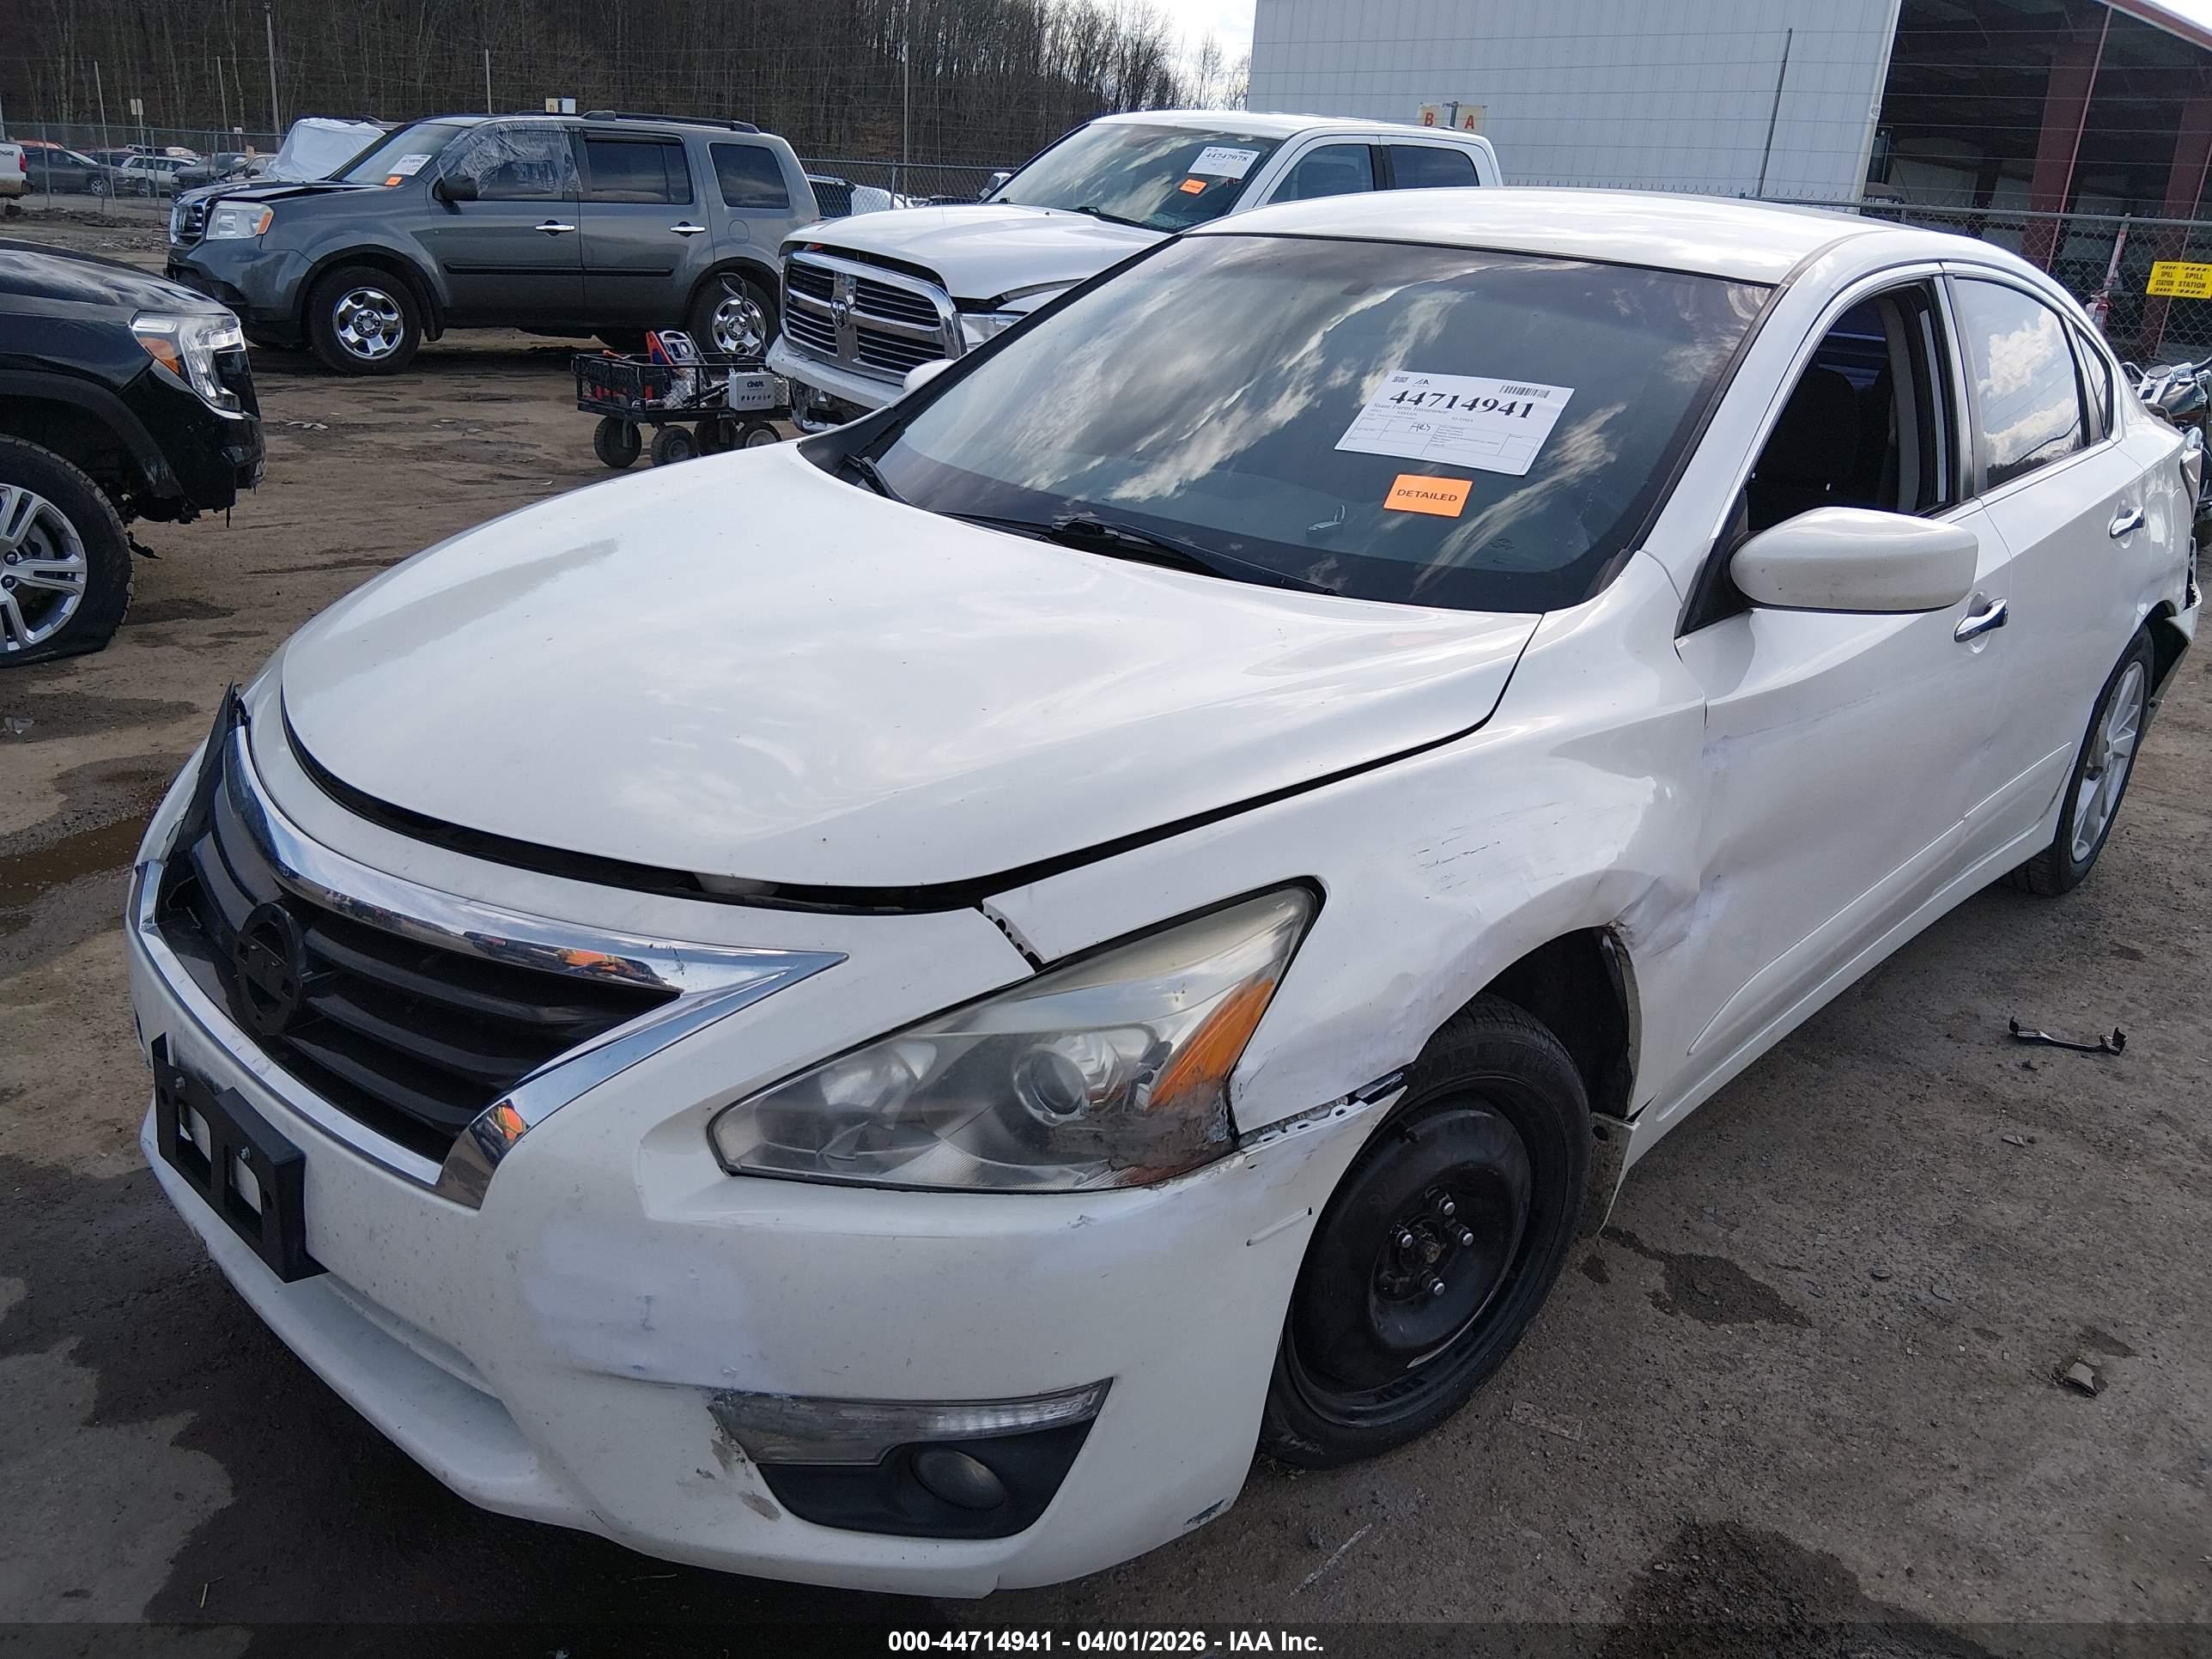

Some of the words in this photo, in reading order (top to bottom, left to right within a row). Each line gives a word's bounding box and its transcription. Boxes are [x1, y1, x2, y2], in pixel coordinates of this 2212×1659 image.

[1425, 112, 1434, 126] B
[1464, 115, 1474, 129] A
[1389, 390, 1534, 419] 44714941
[1396, 489, 1458, 502] DETAILED
